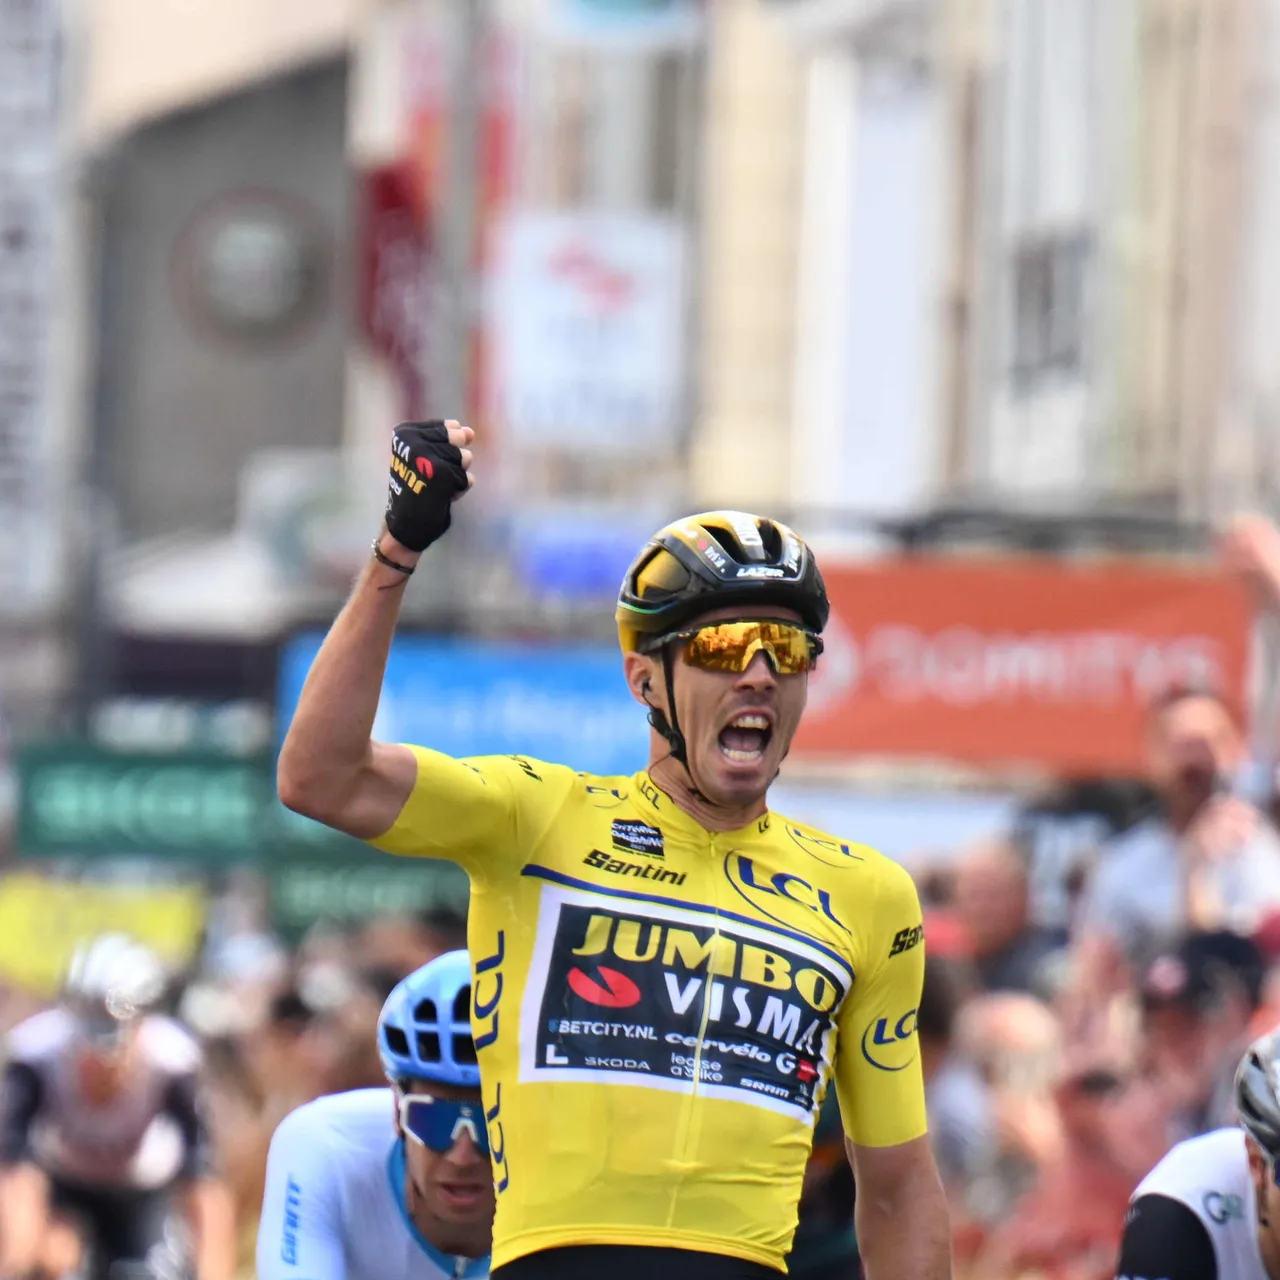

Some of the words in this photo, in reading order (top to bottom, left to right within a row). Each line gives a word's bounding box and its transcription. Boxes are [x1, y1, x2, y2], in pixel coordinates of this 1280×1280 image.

[736, 566, 785, 578] LAZER
[639, 779, 660, 810] LCL
[583, 849, 688, 887] Santini
[737, 855, 853, 937] LCL
[572, 913, 839, 1013] JUMBO
[475, 930, 505, 1050] LCL
[558, 1020, 658, 1041] BETCITY.NL
[663, 971, 818, 1057] VISMA
[664, 1033, 772, 1063] cervélo
[670, 1052, 722, 1072] lease
[485, 1082, 509, 1194] LCL
